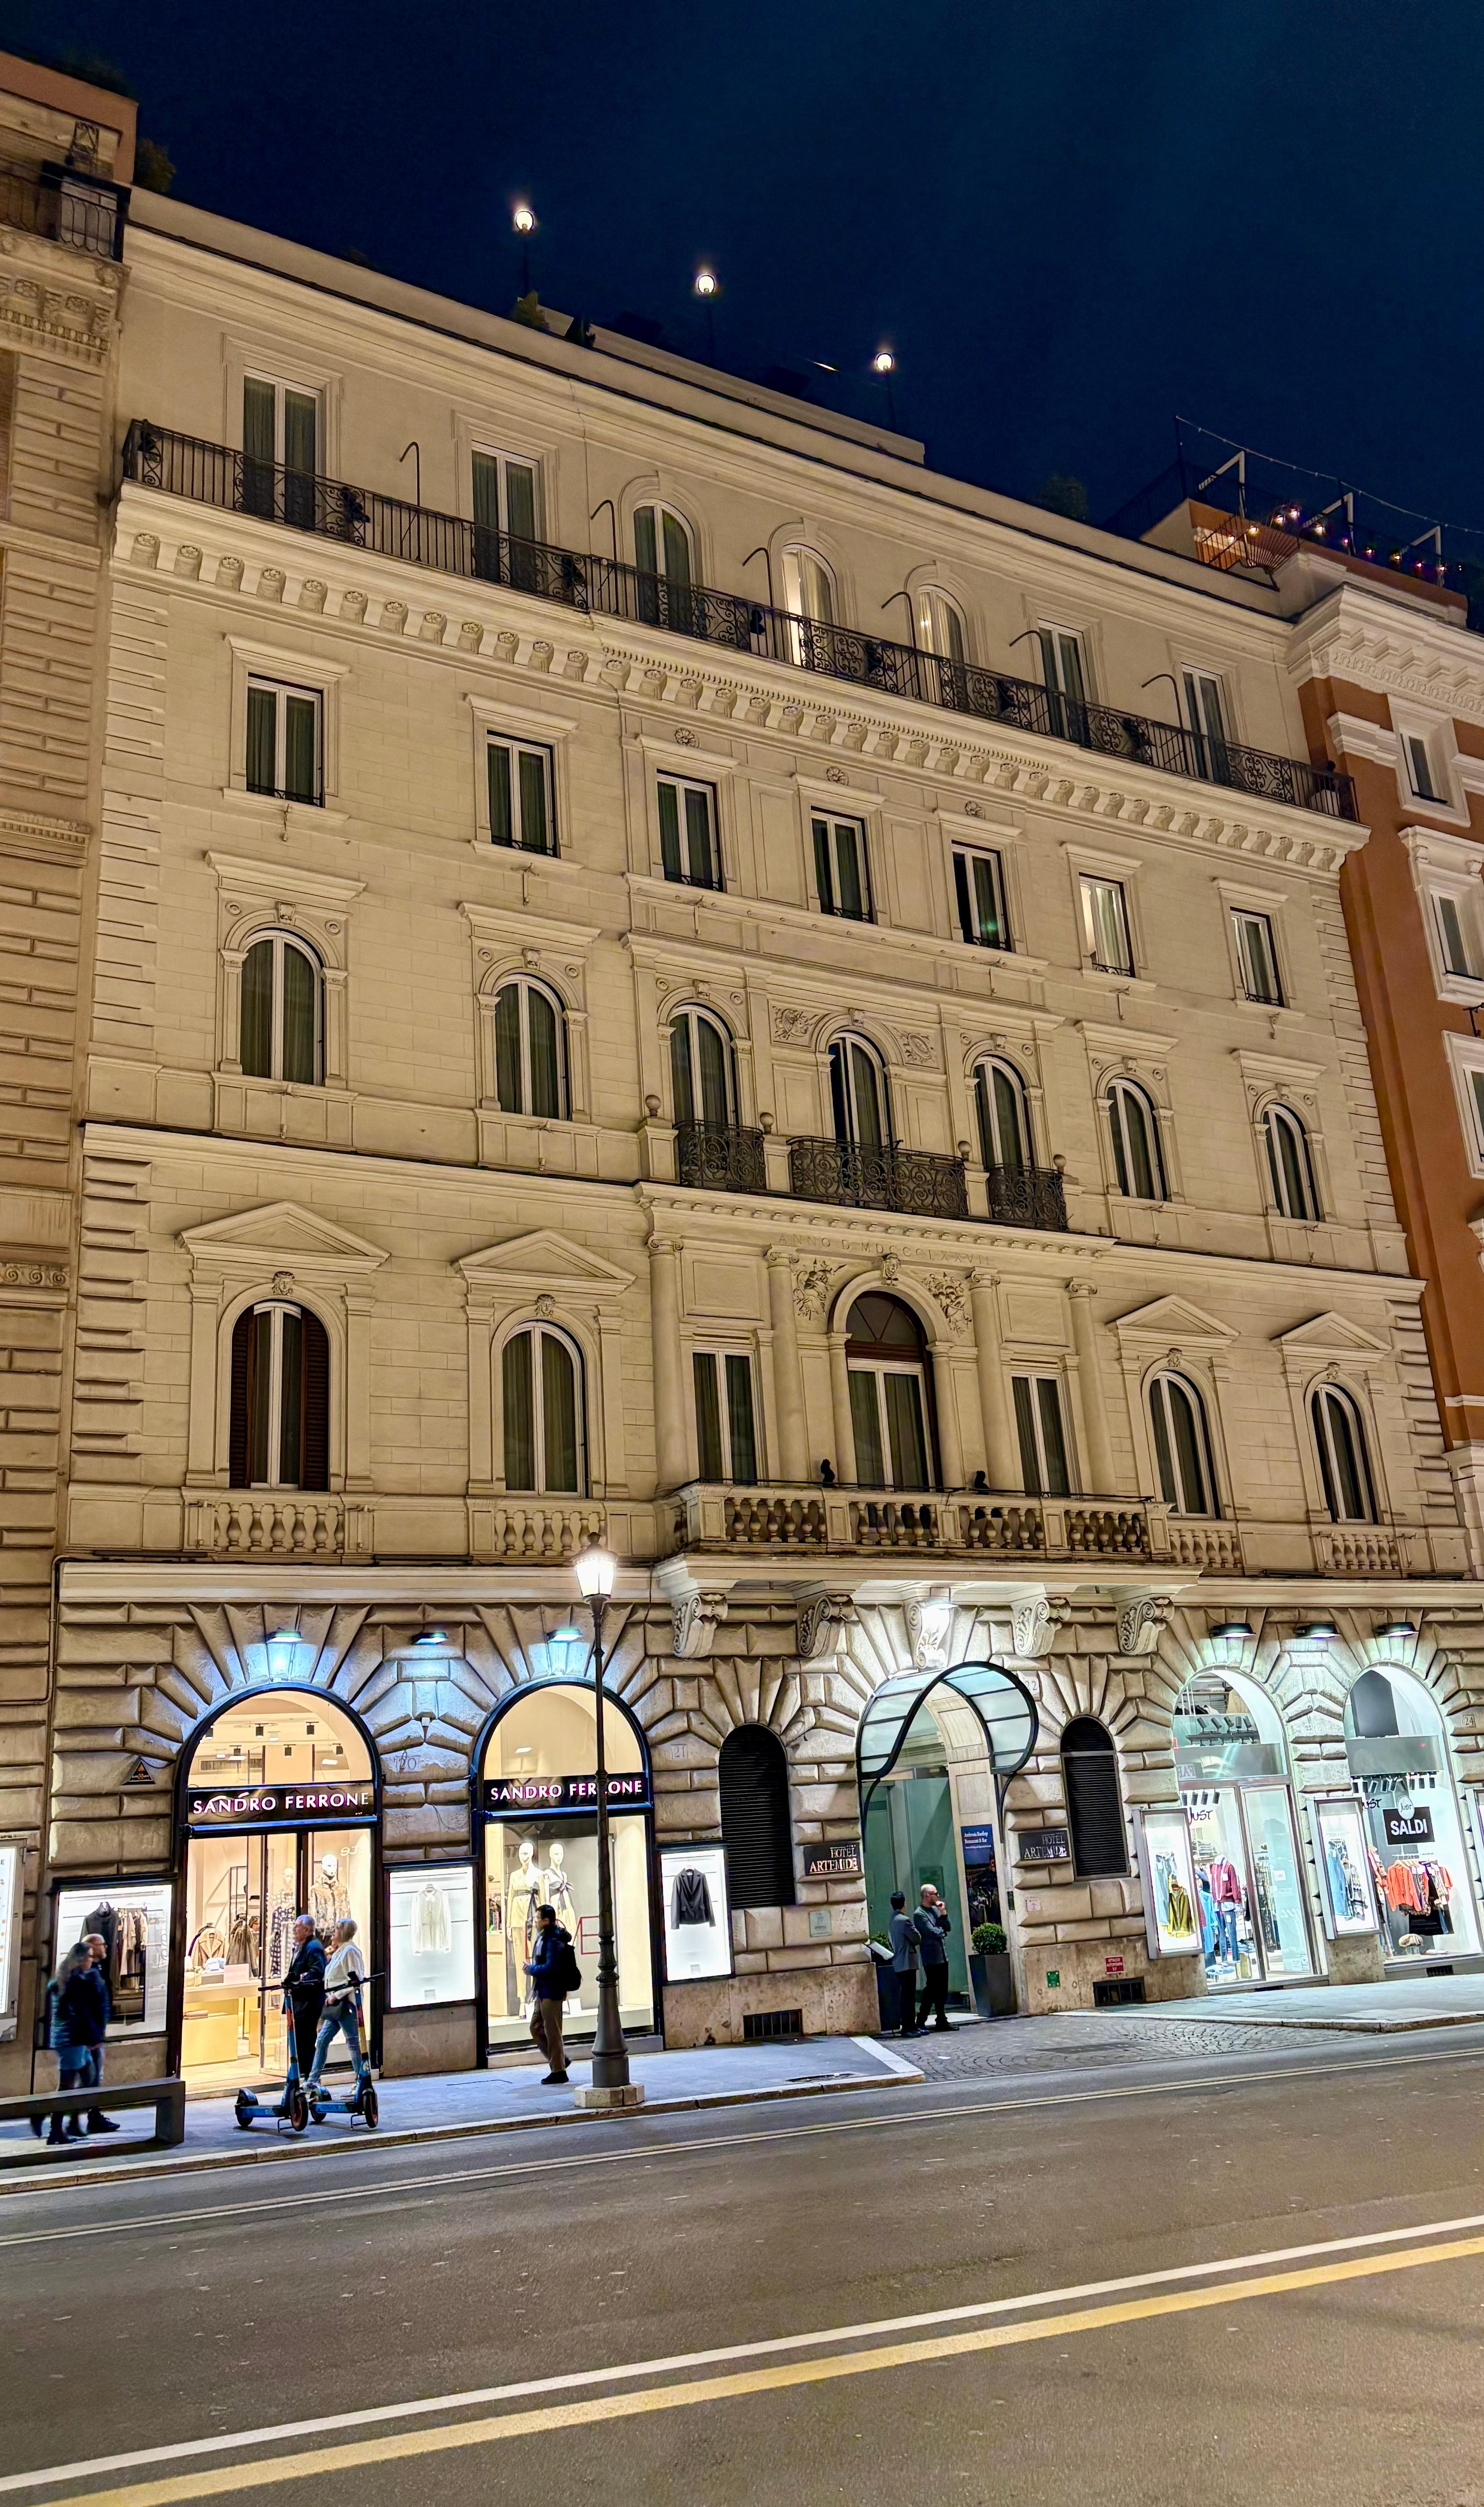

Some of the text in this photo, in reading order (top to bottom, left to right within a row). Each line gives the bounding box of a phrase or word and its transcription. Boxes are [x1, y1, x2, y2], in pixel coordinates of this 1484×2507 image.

[778, 1234, 831, 1247] ANNO
[1464, 1716, 1474, 1726] 24
[491, 1781, 642, 1800] SANDRO FERONE
[193, 1792, 369, 1814] SANDRO FERRONE
[1362, 1798, 1382, 1809] UST
[1390, 1818, 1428, 1836] SALDI
[1042, 1835, 1065, 1845] HOTEL
[831, 1847, 857, 1858] HOTEL
[1024, 1845, 1067, 1857] ARTEMIDE
[810, 1857, 858, 1872] ARTEMIDE
